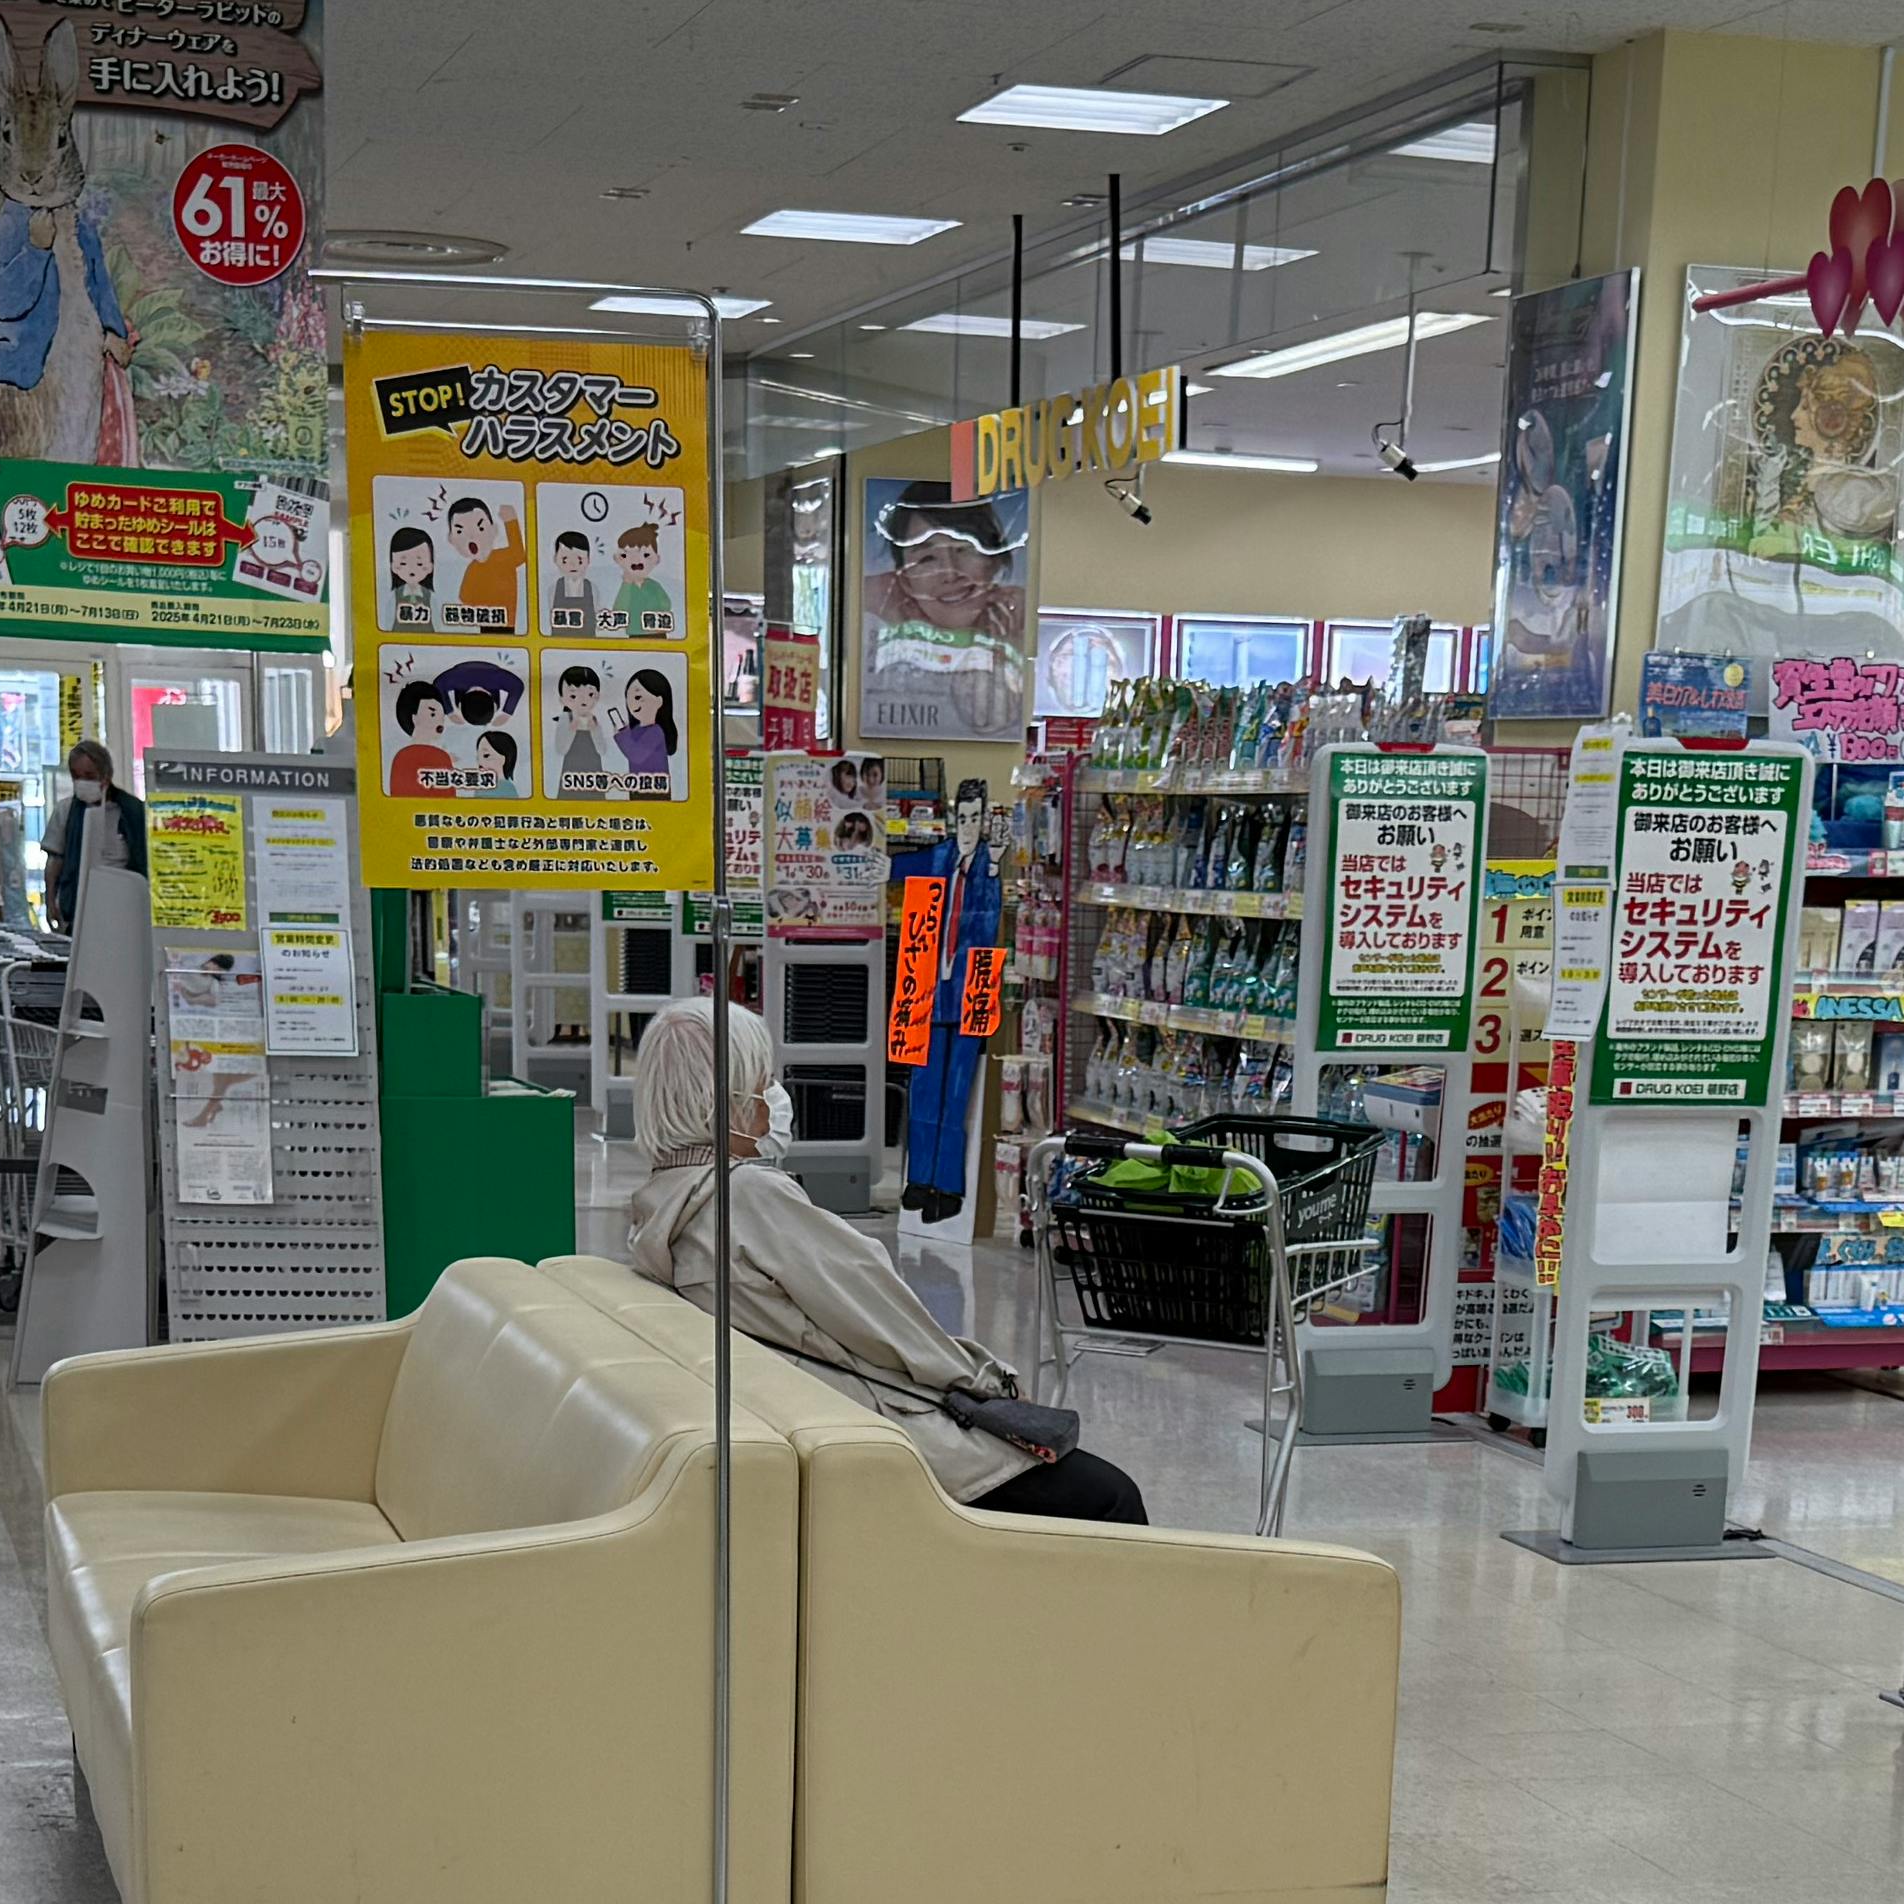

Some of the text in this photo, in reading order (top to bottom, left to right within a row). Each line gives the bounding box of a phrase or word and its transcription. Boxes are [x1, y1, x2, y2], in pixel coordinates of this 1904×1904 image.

[91, 22, 235, 53] ディナーウェアを
[89, 57, 280, 102] 手に入れよう!
[182, 173, 245, 237] 61
[200, 240, 280, 267] お得に!
[389, 382, 466, 418] STOP!
[470, 365, 656, 415] カスタマー
[461, 415, 681, 467] ハラスメント
[977, 365, 1180, 497] DRUG KOEI
[74, 491, 217, 516] ゆめカードご利用で
[74, 511, 217, 537] 貯まったゆめシールは
[76, 532, 217, 557] ここで確認できます
[878, 703, 939, 727] ELIXIR
[182, 767, 330, 788] INFORMATION
[1629, 758, 1791, 782] 本日は御来店頂き誠に
[1343, 778, 1472, 797] ありがとうございます
[1631, 783, 1786, 805] ありがとうございます
[1345, 802, 1467, 822] 御来店のお客様へ
[1634, 811, 1778, 836] 御来店のお客様へ
[1377, 824, 1436, 847] お願い
[1670, 837, 1739, 864] お願い
[1341, 855, 1407, 873] 当店では
[1340, 875, 1466, 901] セキュリティ
[1626, 871, 1703, 894] 当店では
[1340, 903, 1443, 929] システムを
[1491, 905, 1508, 943] 1
[1623, 898, 1773, 928] セキュリティ
[1339, 931, 1463, 950] 導入しております
[1619, 930, 1742, 960] システムを
[1480, 957, 1509, 997] 2
[1619, 962, 1765, 986] 導入しております
[1475, 1014, 1501, 1055] 3
[1636, 1083, 1671, 1095] DRUG
[1675, 1083, 1704, 1095] KOEI
